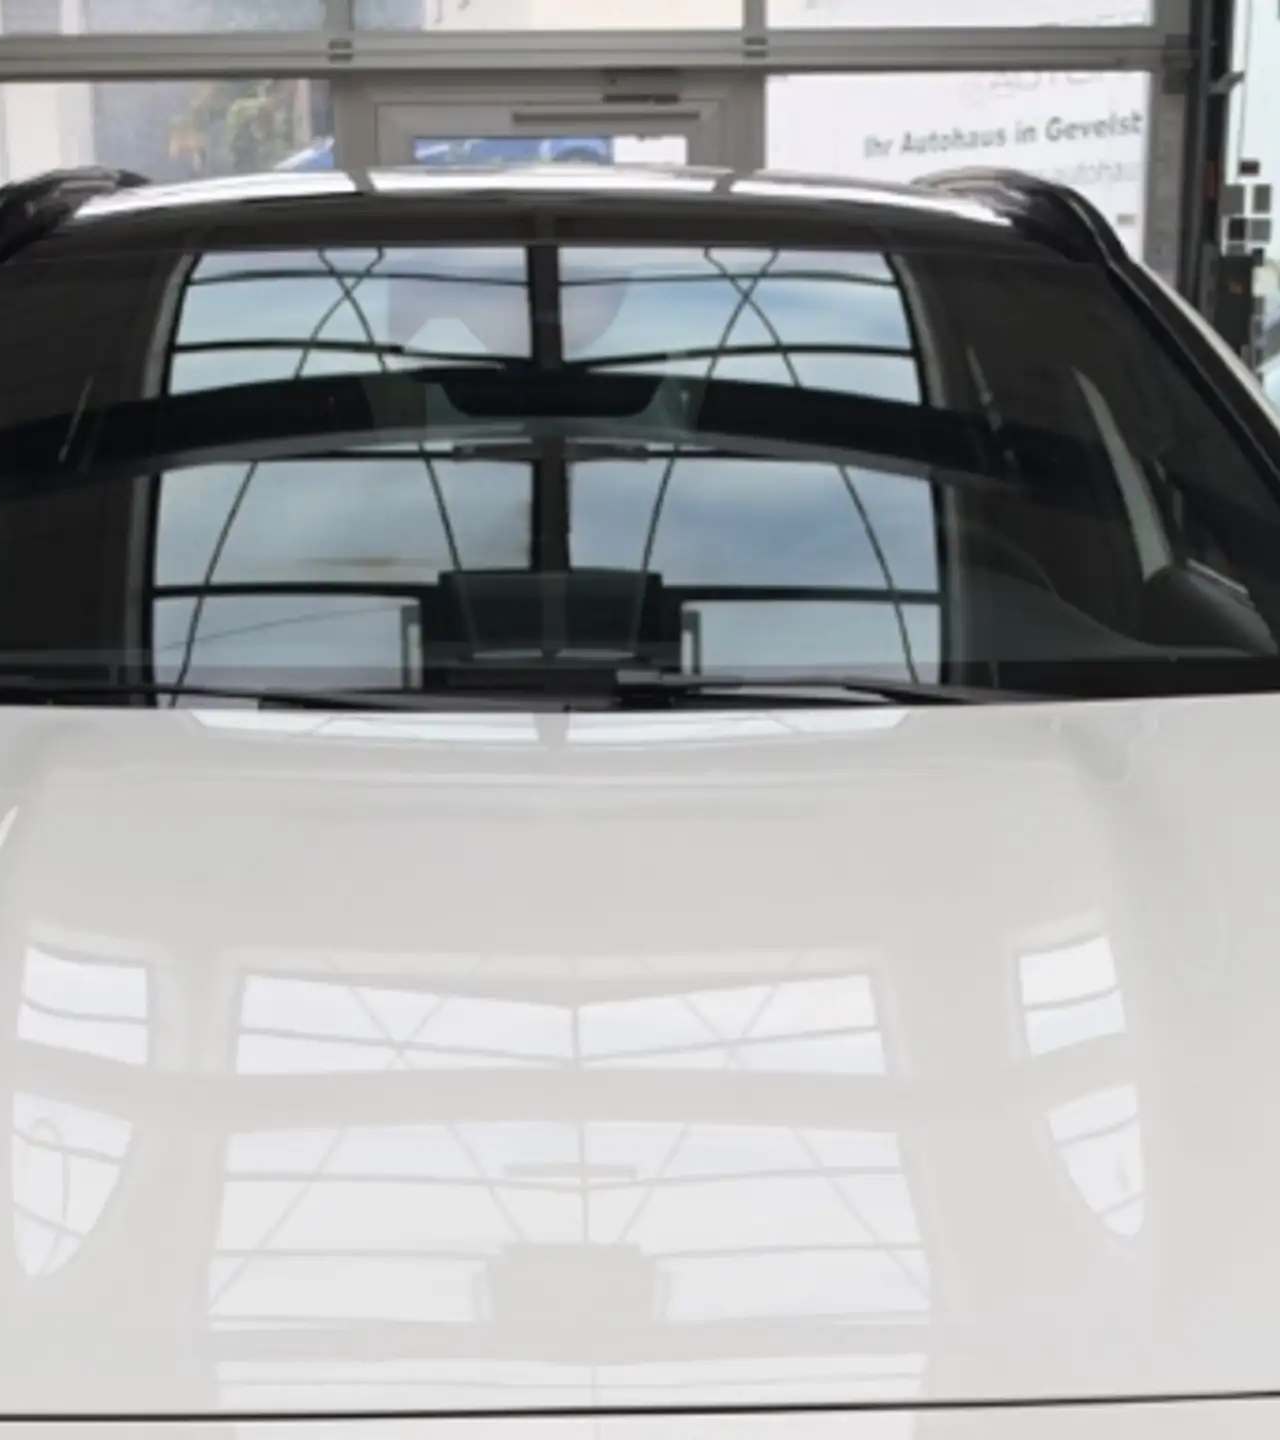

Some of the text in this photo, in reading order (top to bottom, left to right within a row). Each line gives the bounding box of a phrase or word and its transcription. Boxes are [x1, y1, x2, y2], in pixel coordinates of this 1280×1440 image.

[864, 135, 893, 157] Ihr
[900, 127, 1007, 155] Autohaus
[1016, 121, 1038, 144] in
